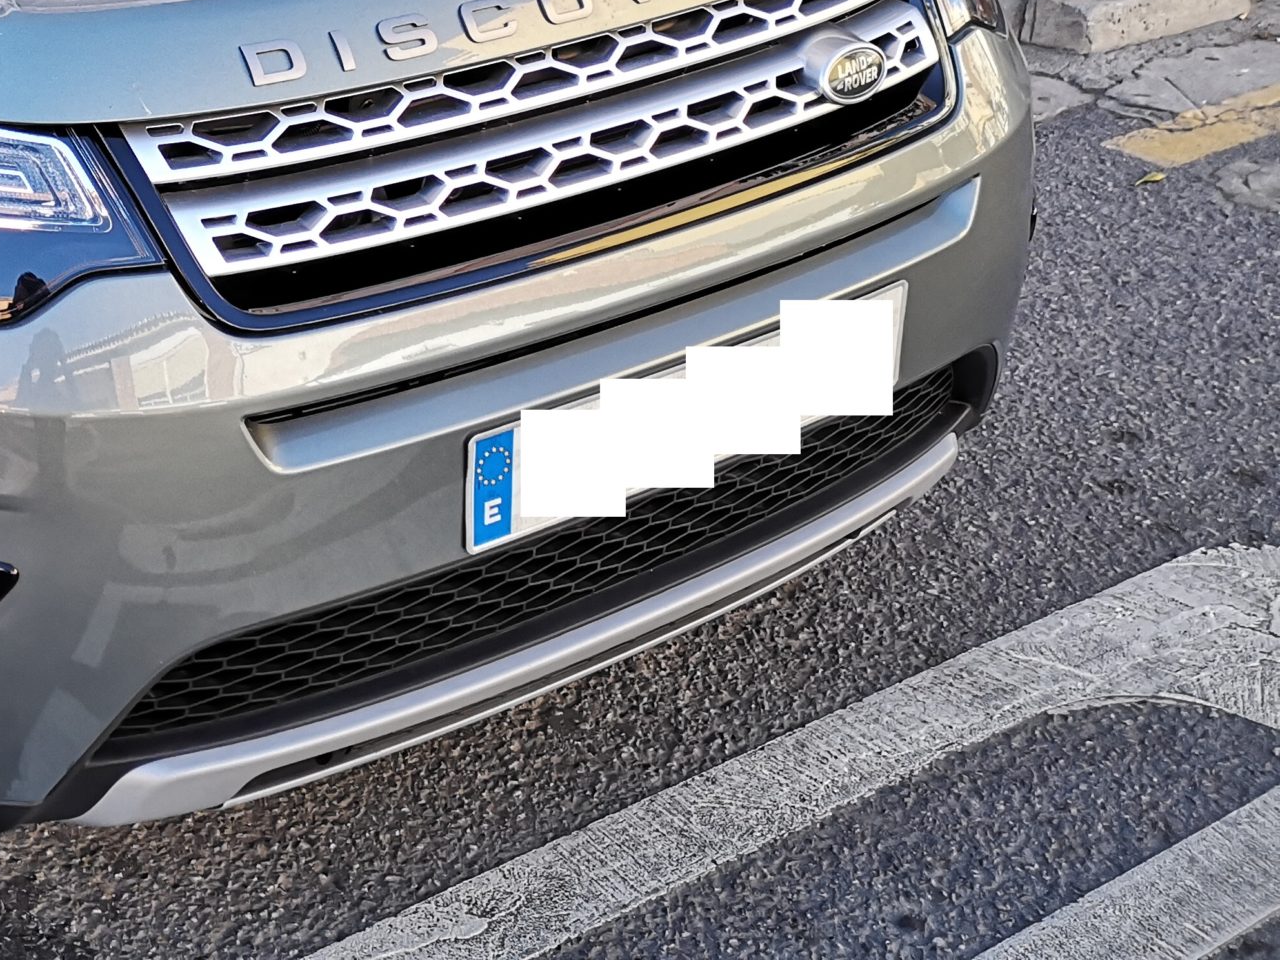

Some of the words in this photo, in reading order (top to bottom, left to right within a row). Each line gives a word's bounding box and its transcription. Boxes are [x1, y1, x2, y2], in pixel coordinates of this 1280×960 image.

[837, 55, 866, 79] LAND
[844, 66, 878, 92] ROVER
[483, 497, 502, 526] E
